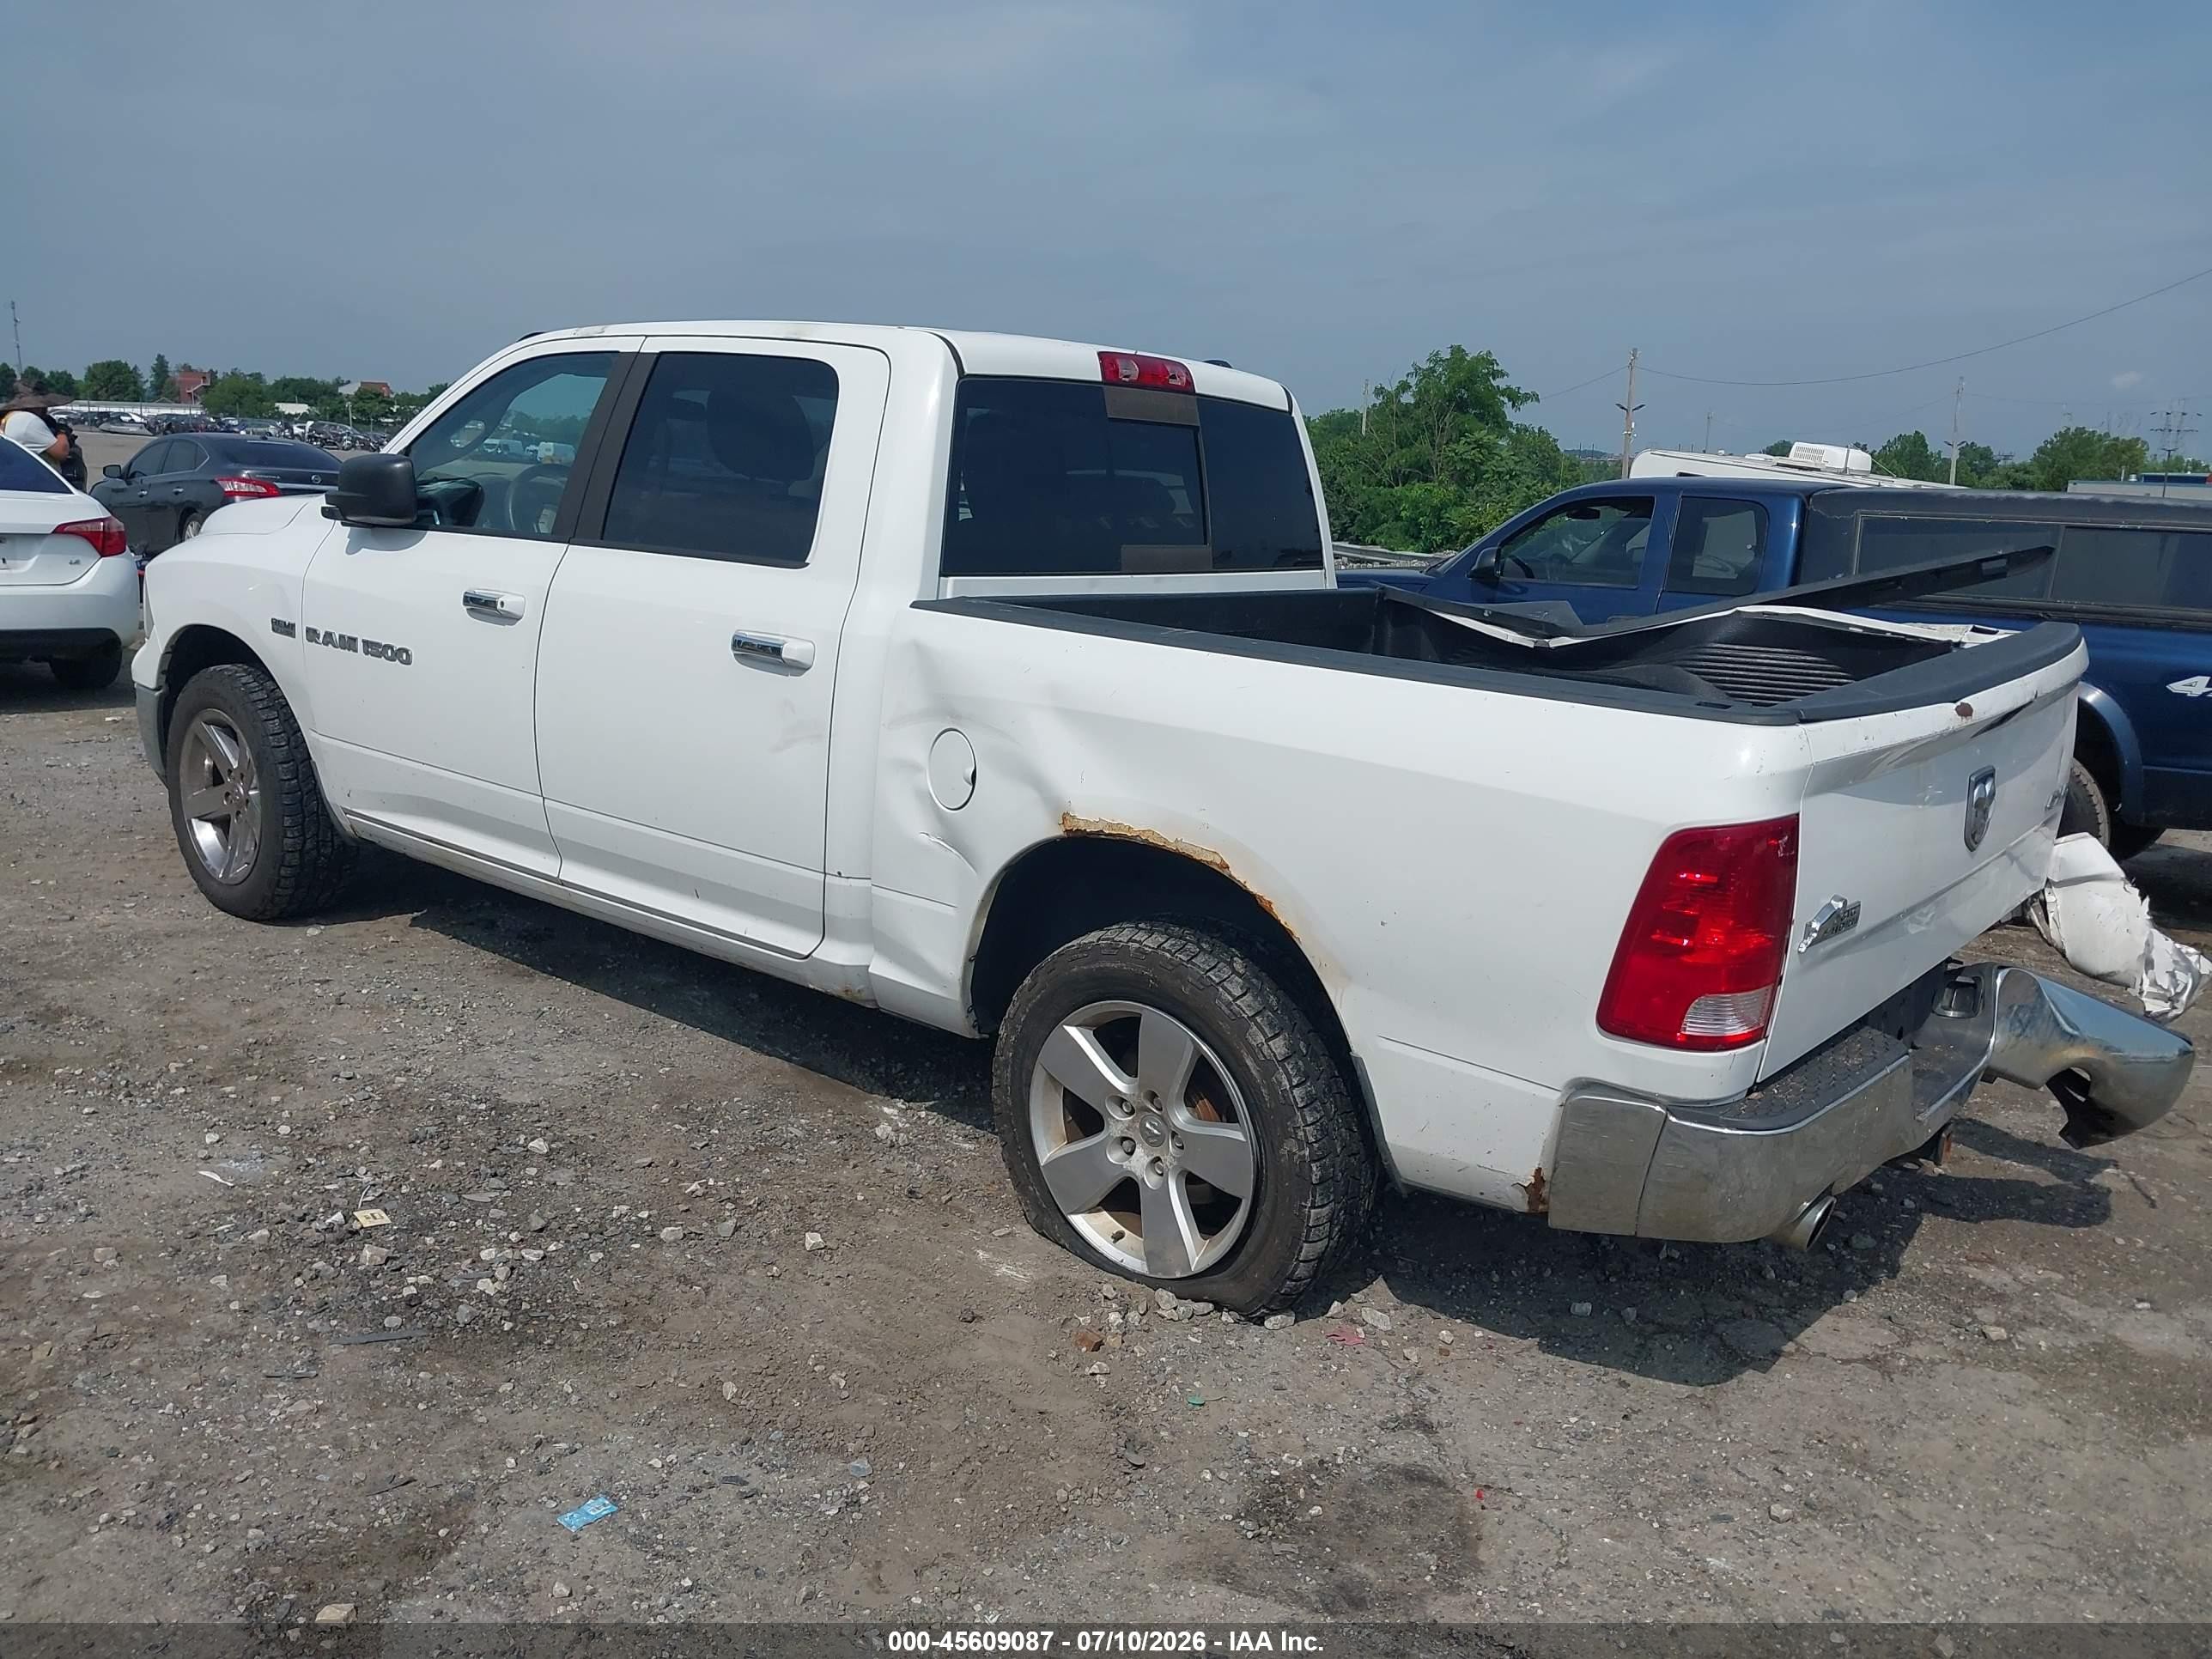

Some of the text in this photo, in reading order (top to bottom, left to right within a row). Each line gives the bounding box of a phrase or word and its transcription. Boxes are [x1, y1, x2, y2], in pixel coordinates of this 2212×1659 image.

[306, 626, 358, 653] RAM
[362, 639, 413, 665] 1500
[2166, 675, 2212, 696] 4
